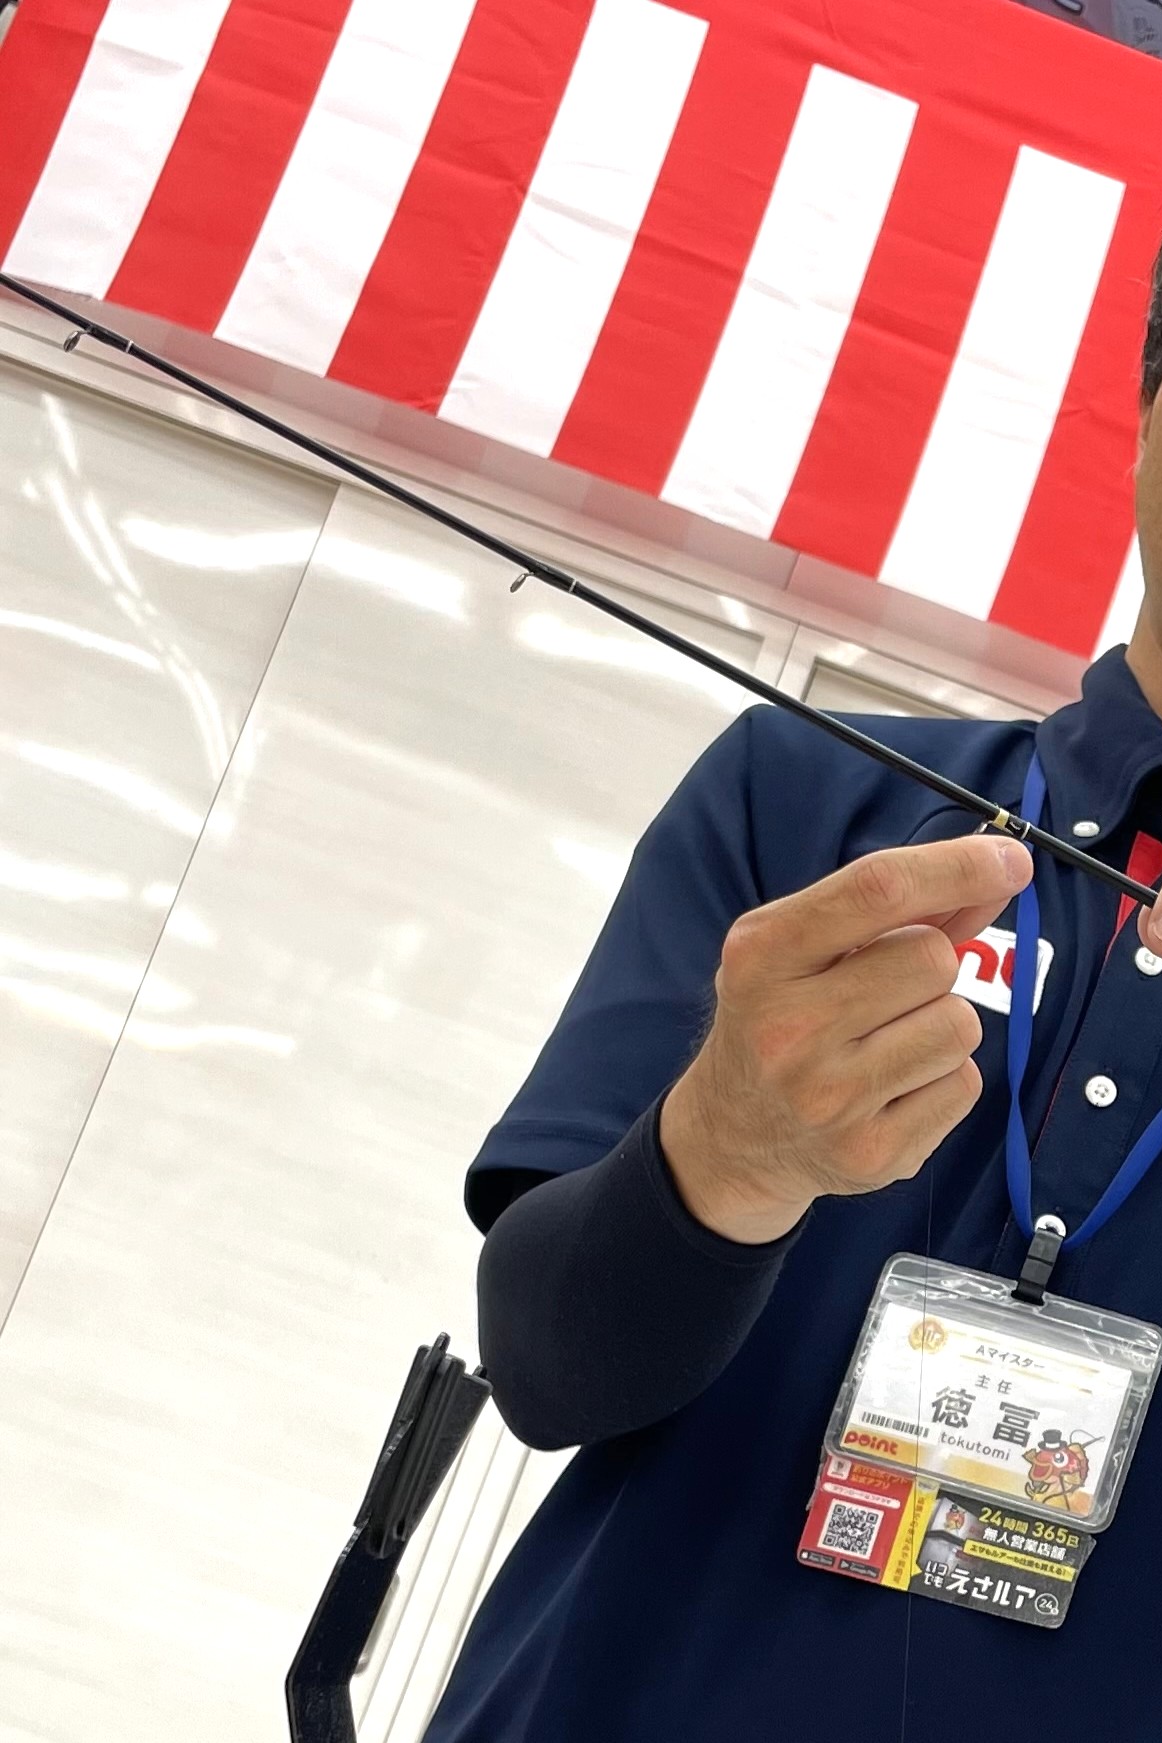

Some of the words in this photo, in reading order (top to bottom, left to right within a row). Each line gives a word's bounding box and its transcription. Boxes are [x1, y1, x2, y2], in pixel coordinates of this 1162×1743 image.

[976, 1345, 1045, 1369] Aマイスター
[844, 1431, 899, 1456] point
[940, 1431, 1010, 1461] tokutomi
[979, 1507, 1029, 1534] 24時間
[1032, 1522, 1079, 1548] 365日
[924, 1572, 944, 1588] でも
[926, 1560, 948, 1576] いつ
[945, 1568, 1036, 1609] えさルア
